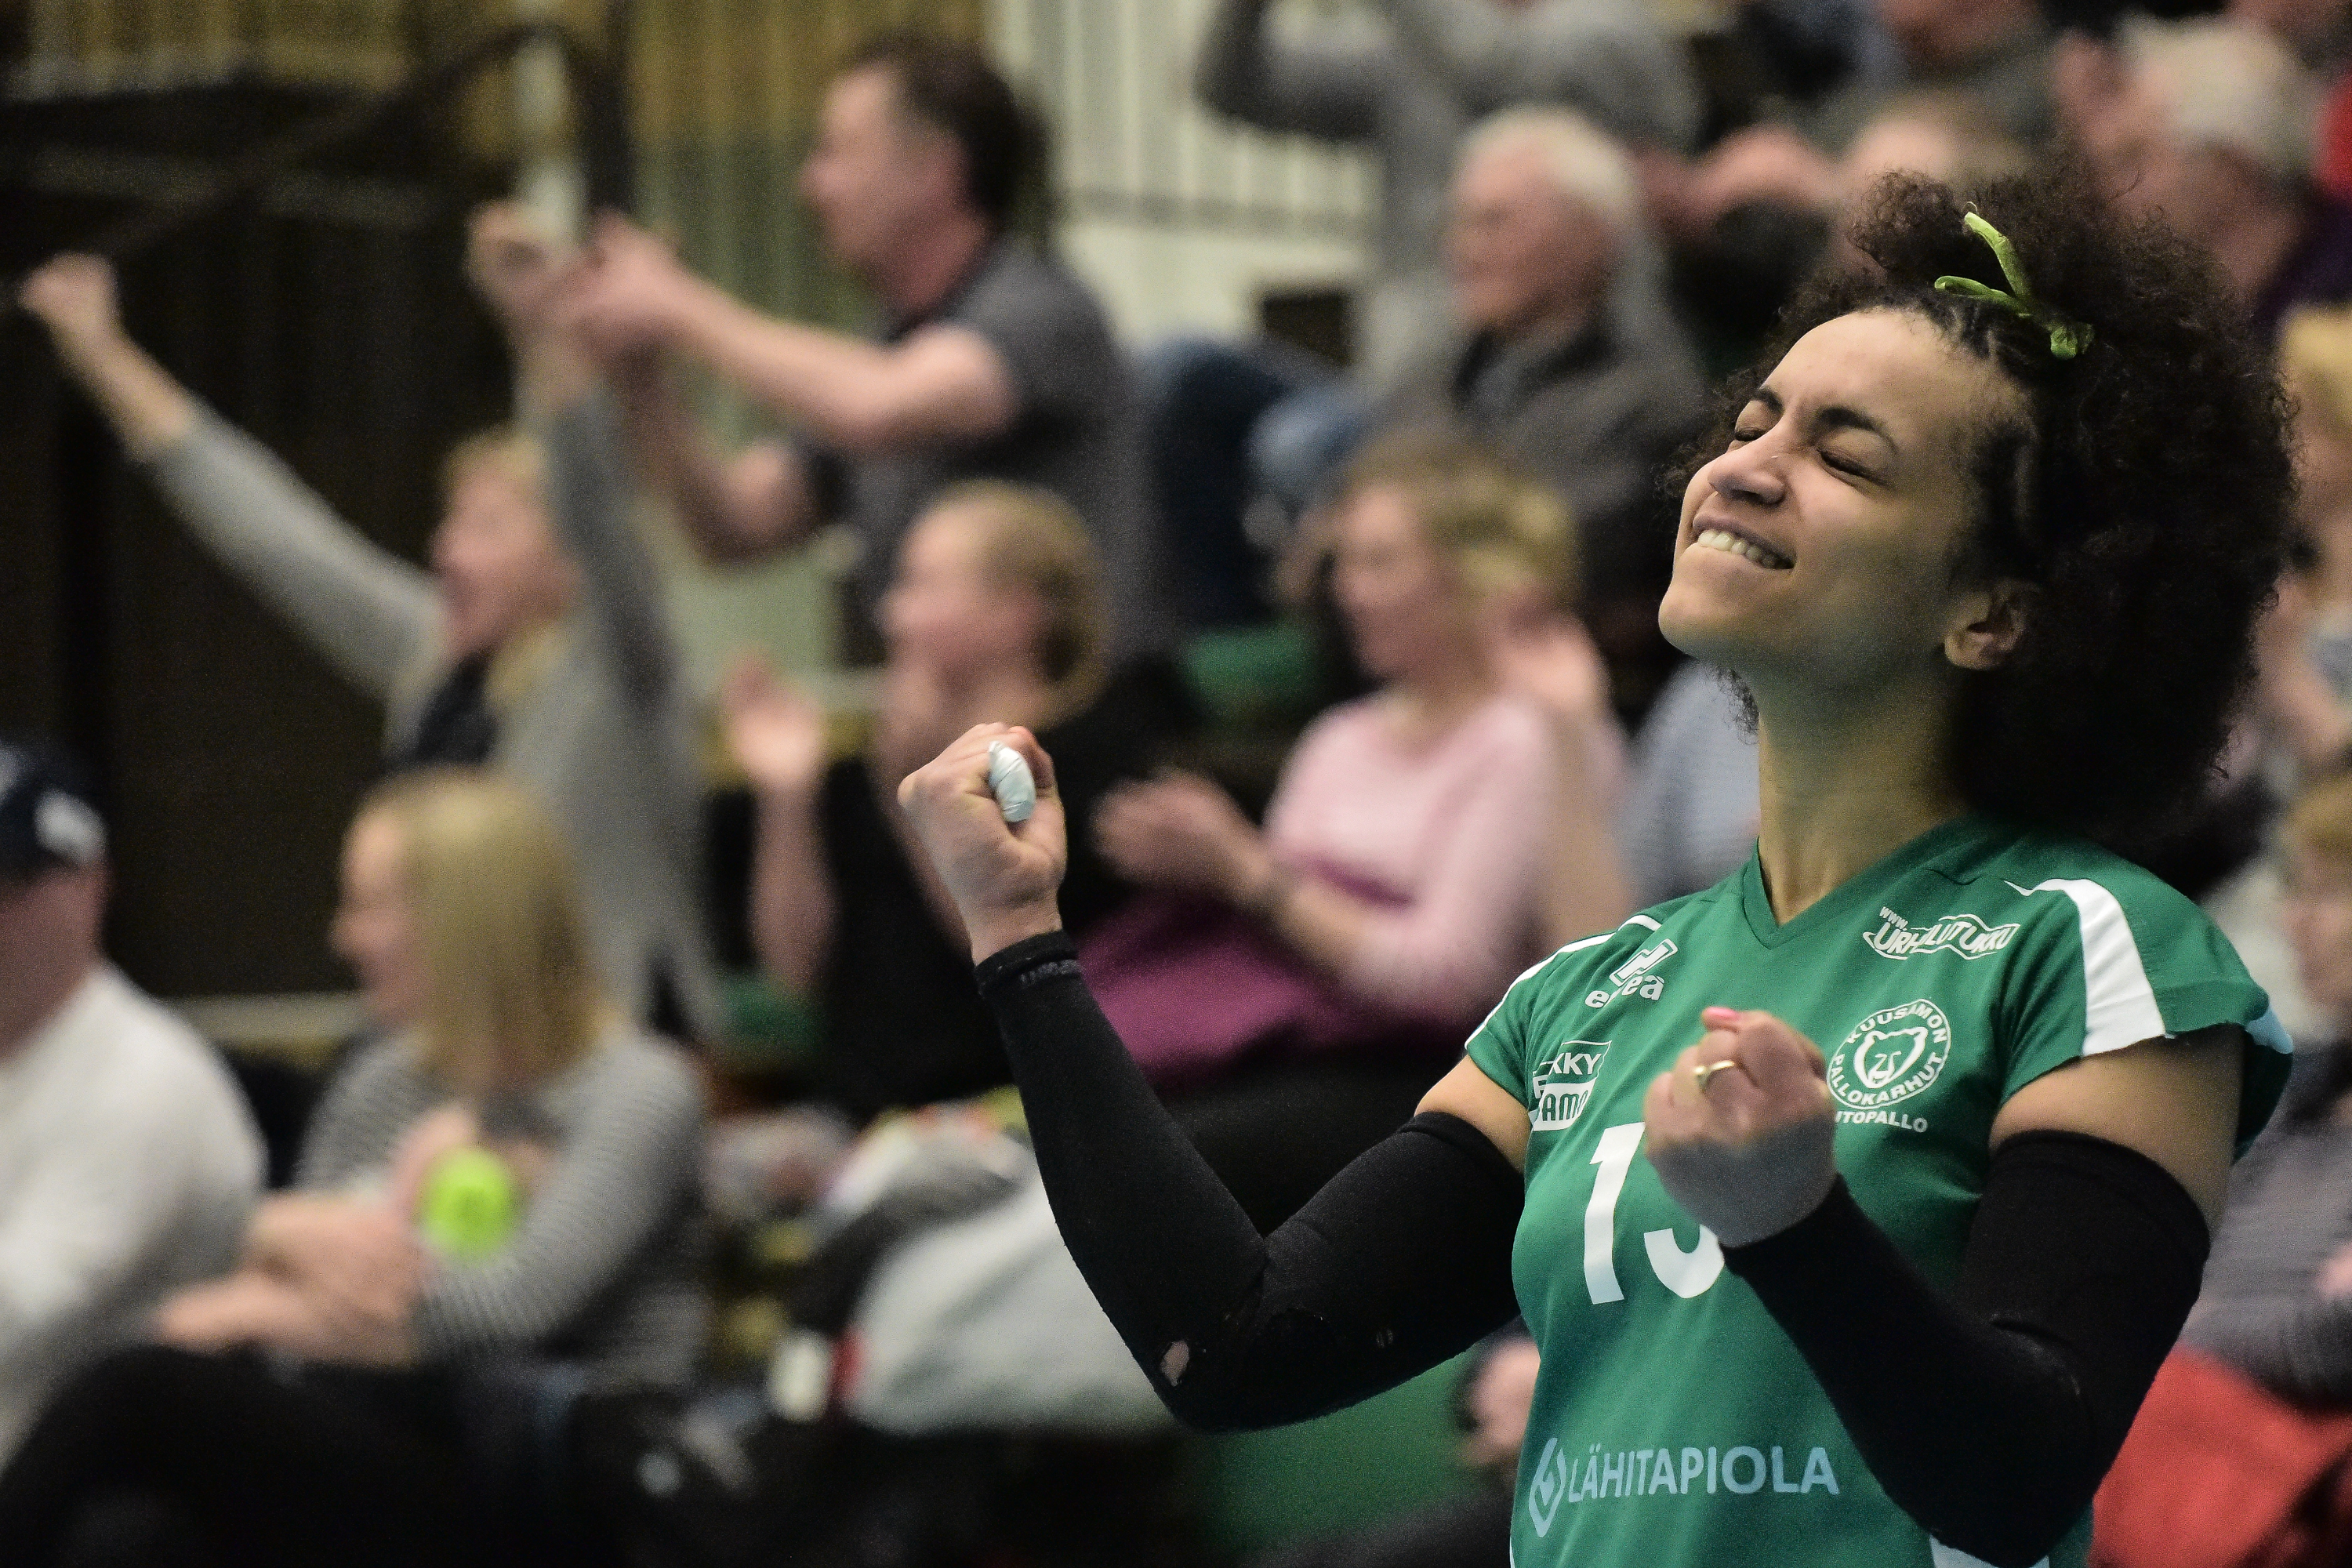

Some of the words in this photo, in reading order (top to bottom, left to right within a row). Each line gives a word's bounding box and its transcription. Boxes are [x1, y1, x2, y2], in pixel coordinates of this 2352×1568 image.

[1846, 1004, 1948, 1044] KUUSAMON
[1830, 1051, 1942, 1105] PALLOKARHUT
[1835, 1110, 1928, 1133] TOPALLO
[1568, 1443, 1841, 1503] LÄHITAPIOLA
